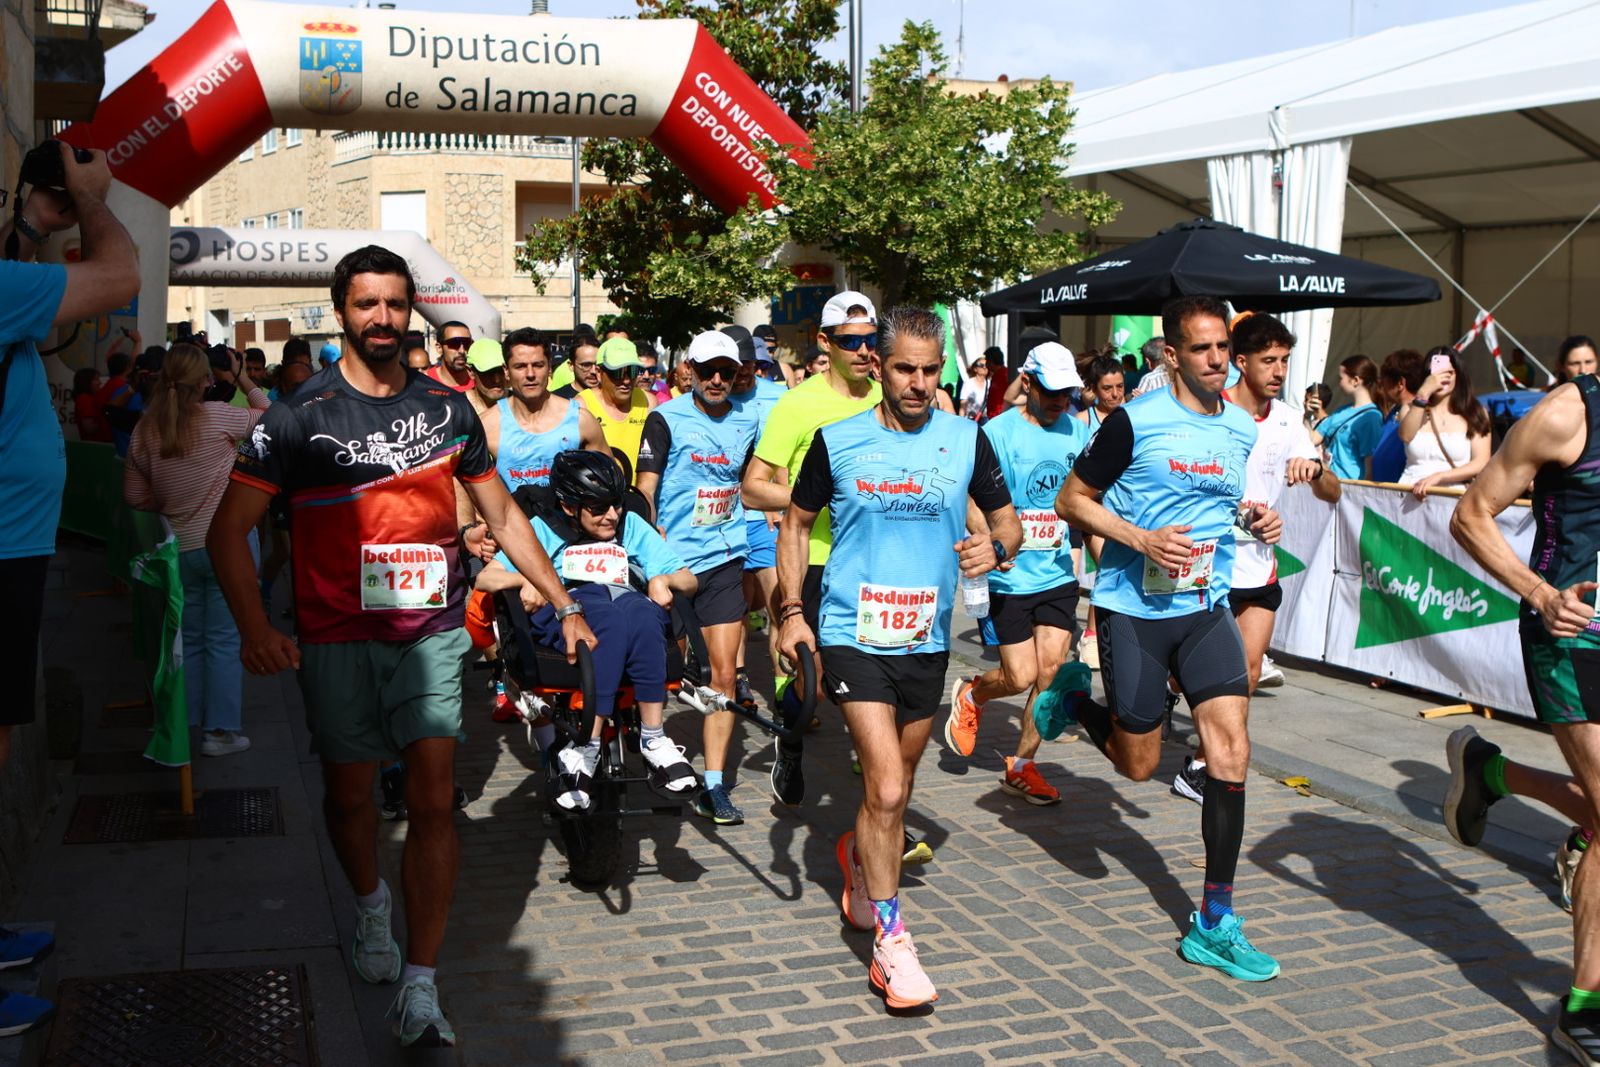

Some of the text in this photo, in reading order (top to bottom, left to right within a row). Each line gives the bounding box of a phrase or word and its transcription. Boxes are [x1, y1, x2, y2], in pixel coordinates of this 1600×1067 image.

[388, 26, 600, 67] Diputación
[385, 77, 637, 117] de Salamanca
[695, 72, 732, 110] CON
[107, 53, 243, 165] CON EL DEPORTE
[213, 240, 329, 263] HOSPES
[170, 269, 241, 281] PALACIO
[247, 270, 267, 281] DE
[271, 271, 302, 281] SAN
[1280, 275, 1345, 293] LA SALVE
[1041, 284, 1088, 304] LA SALVE
[334, 432, 445, 467] Salamanca
[377, 475, 394, 484] CON
[407, 467, 422, 475] LUZ
[708, 501, 730, 515] 100
[888, 499, 938, 513] FLOWERS
[1021, 512, 1059, 522] bedun
[1031, 525, 1056, 539] 168
[364, 548, 444, 564] bedunia
[565, 547, 625, 558] bedunia
[585, 559, 607, 573] 64
[385, 569, 426, 590] 121
[861, 587, 936, 606] bedunia
[1379, 566, 1421, 602] Corte
[1418, 567, 1488, 620] Inglés
[880, 610, 919, 630] 182
